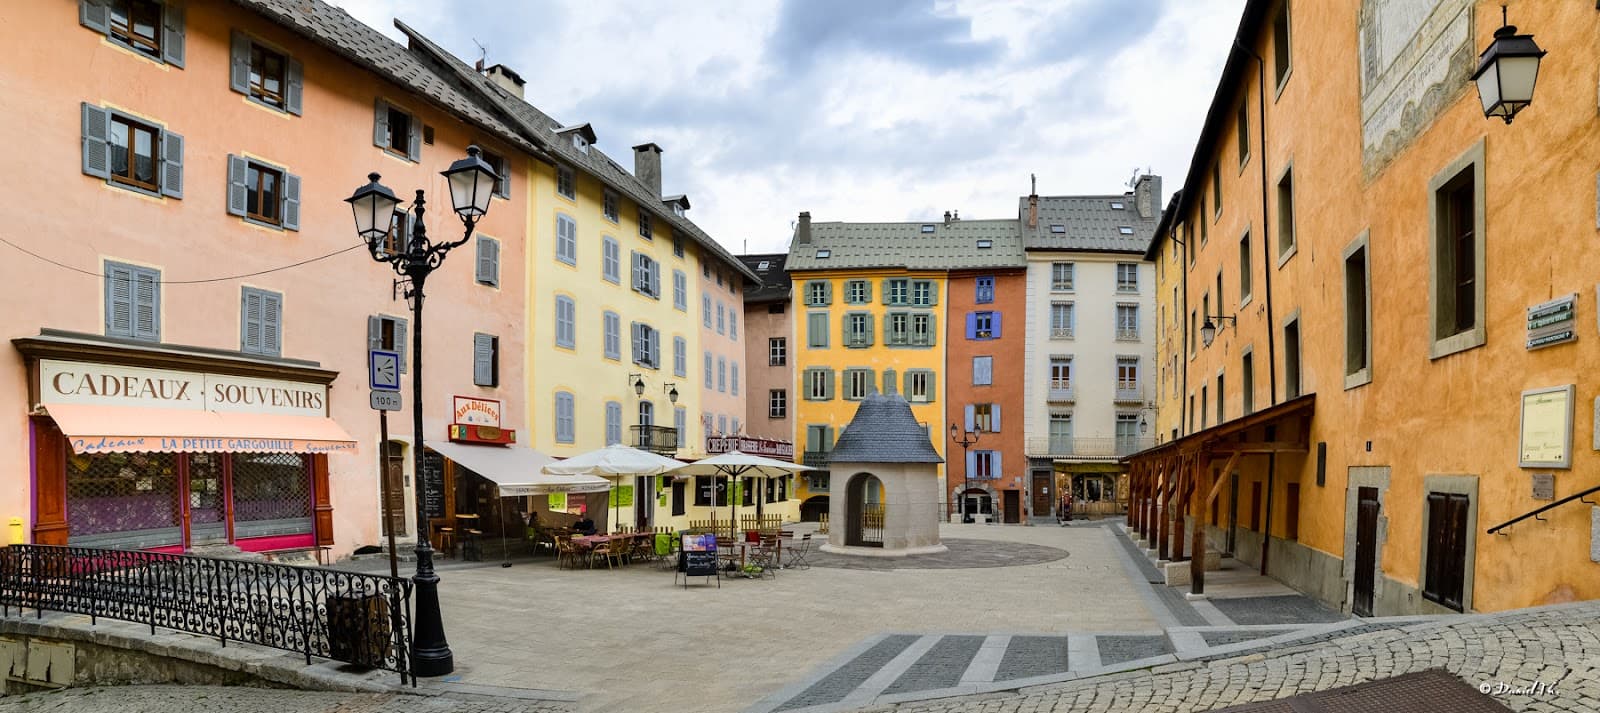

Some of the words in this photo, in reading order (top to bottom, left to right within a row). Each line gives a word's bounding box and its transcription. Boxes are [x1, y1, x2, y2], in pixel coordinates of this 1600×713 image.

[52, 371, 191, 401] CADEAUX
[214, 383, 323, 410] SOUVENIRS
[376, 396, 391, 405] 100
[456, 403, 470, 419] Aux
[73, 437, 145, 451] Cadeaux
[161, 438, 177, 450] LA
[182, 438, 223, 449] PETITE
[227, 439, 294, 450] GARGOUILLE
